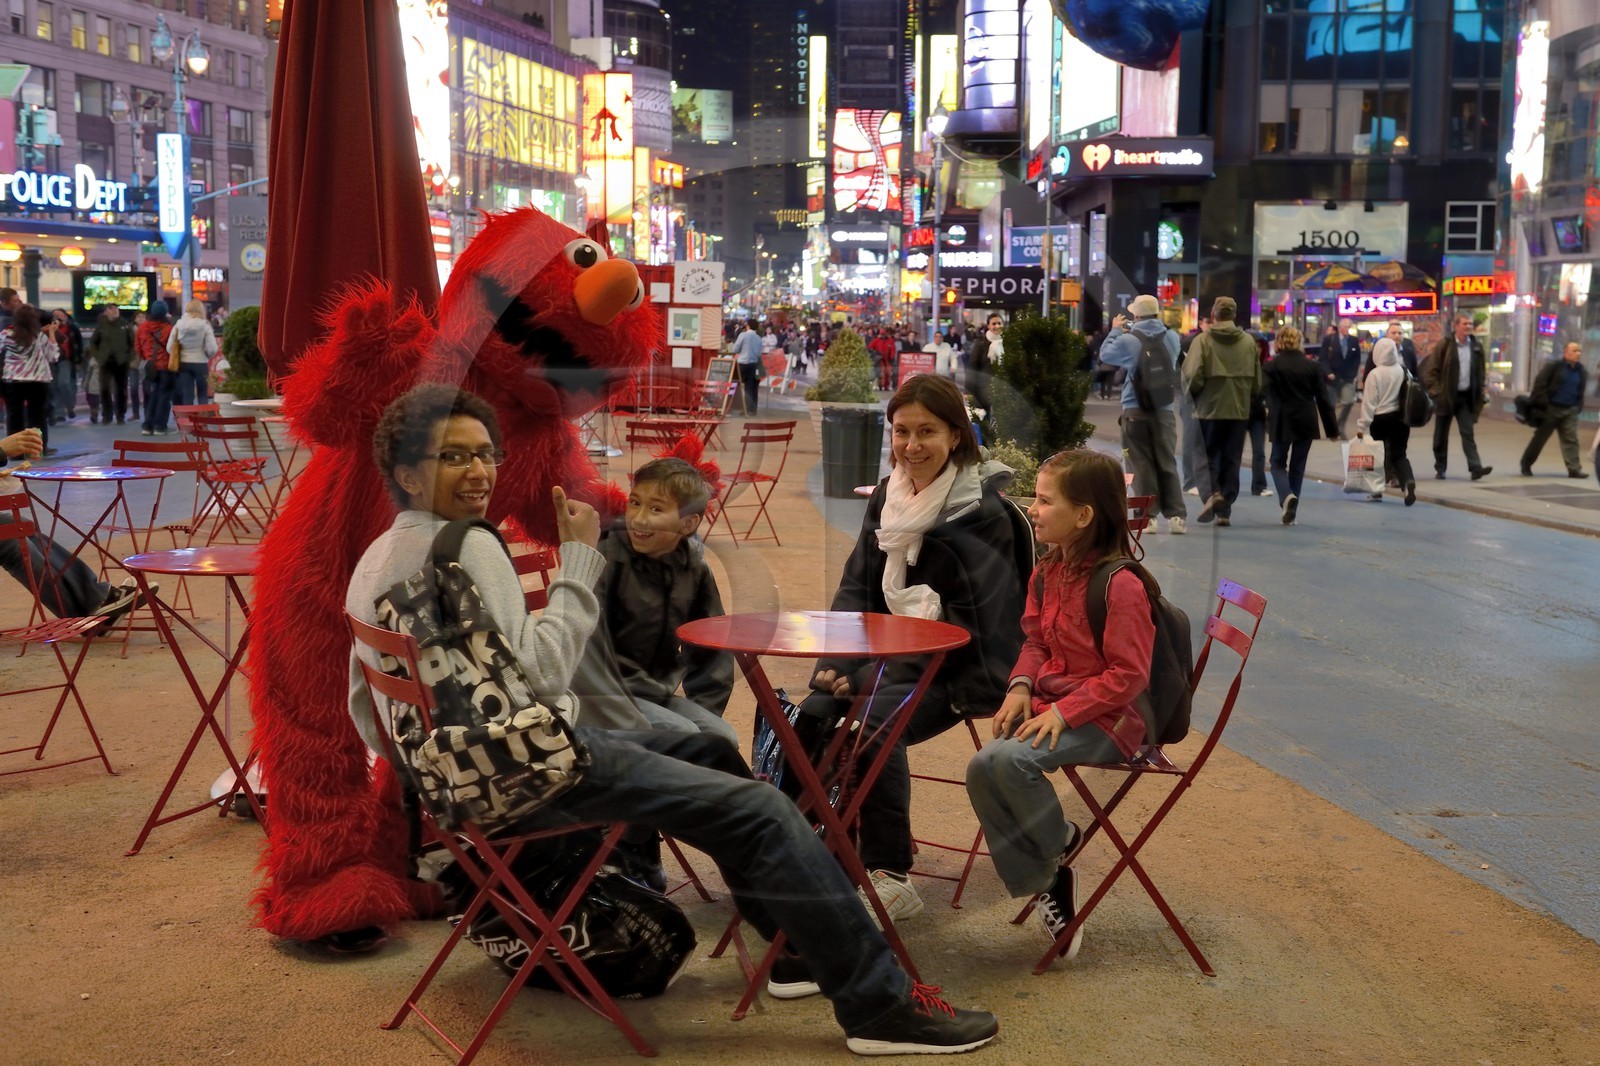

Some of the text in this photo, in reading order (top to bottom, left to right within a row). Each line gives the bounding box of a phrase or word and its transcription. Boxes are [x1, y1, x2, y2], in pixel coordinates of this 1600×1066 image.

[796, 23, 808, 105] NOVOTEL
[1114, 148, 1202, 166] iheartradio
[75, 163, 128, 212] DEPT
[164, 138, 178, 228] NYPD
[1298, 230, 1360, 249] 1500
[938, 277, 1047, 295] SEPHORA
